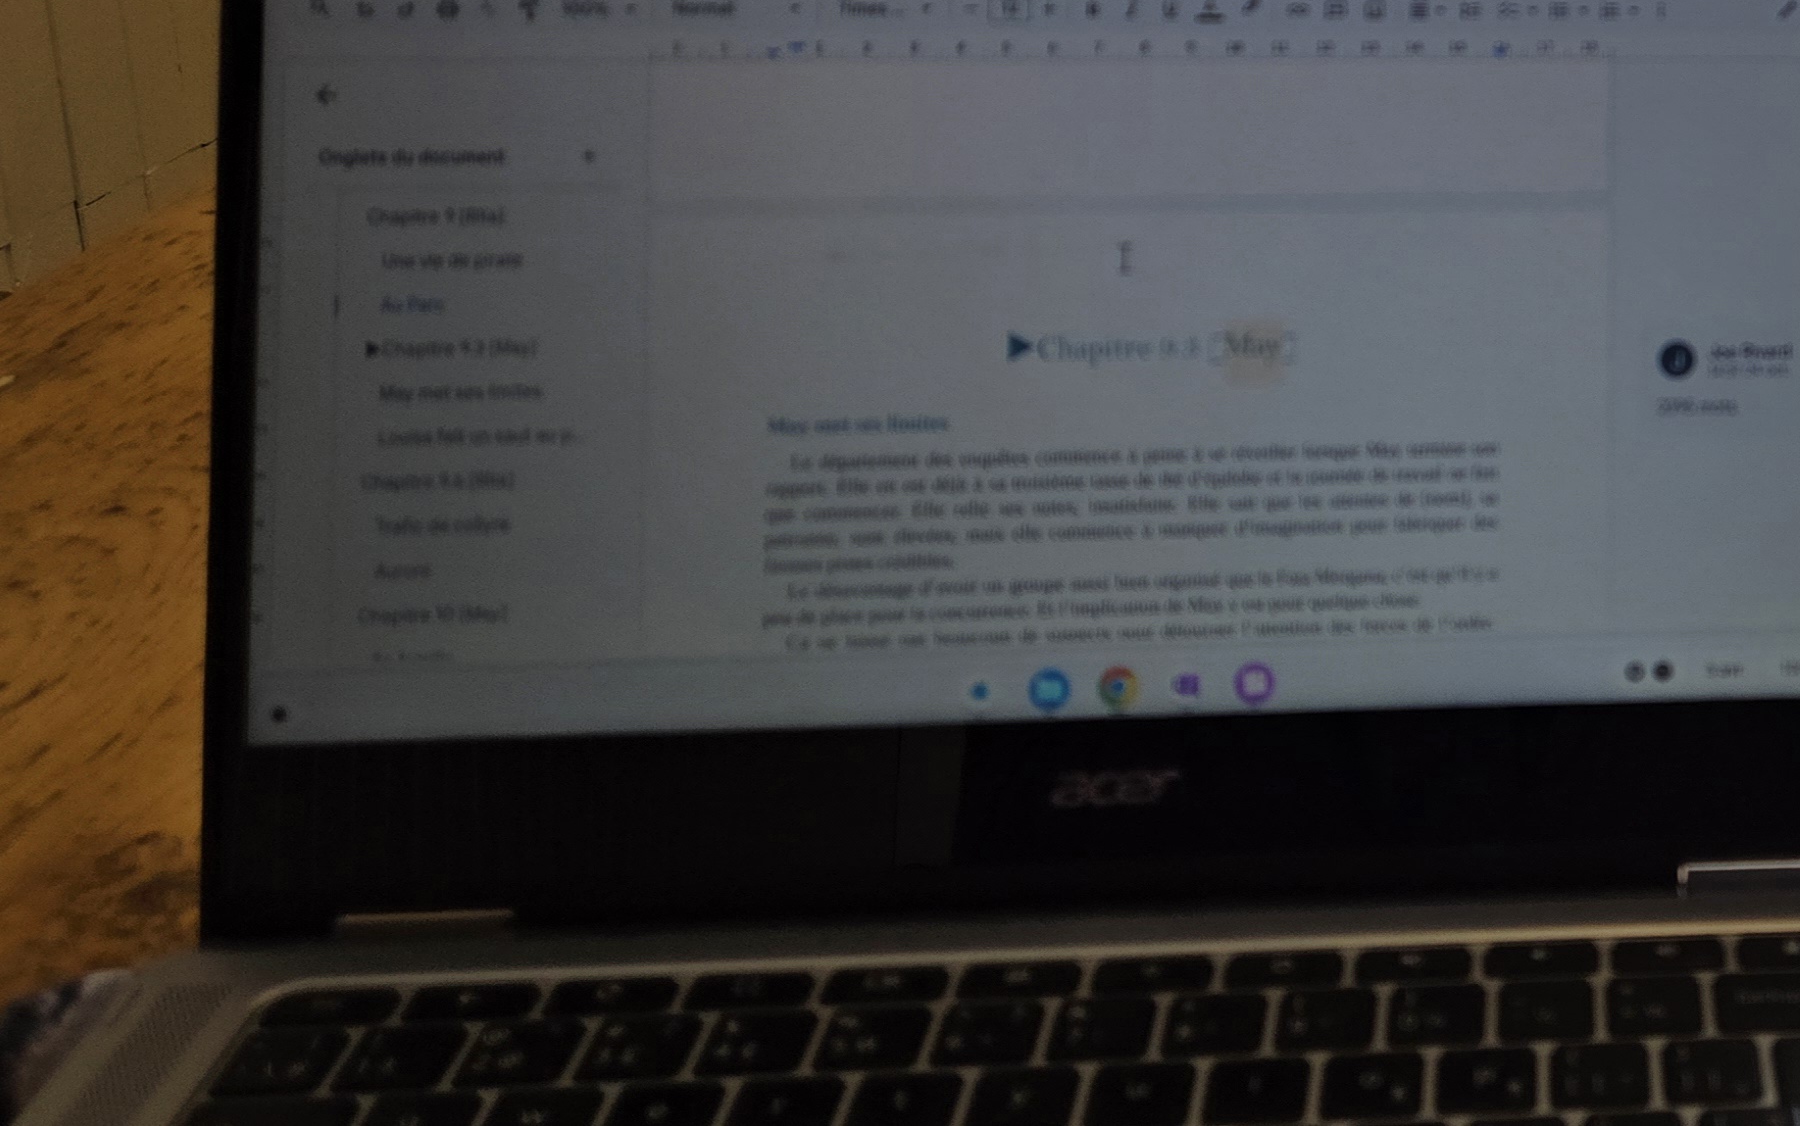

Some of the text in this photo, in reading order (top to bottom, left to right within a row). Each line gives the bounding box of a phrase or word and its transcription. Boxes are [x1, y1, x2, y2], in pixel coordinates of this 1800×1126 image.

[672, 0, 735, 18] Normal
[418, 148, 504, 165] document
[1035, 335, 1154, 368] Chapitre
[1049, 769, 1181, 807] acer
